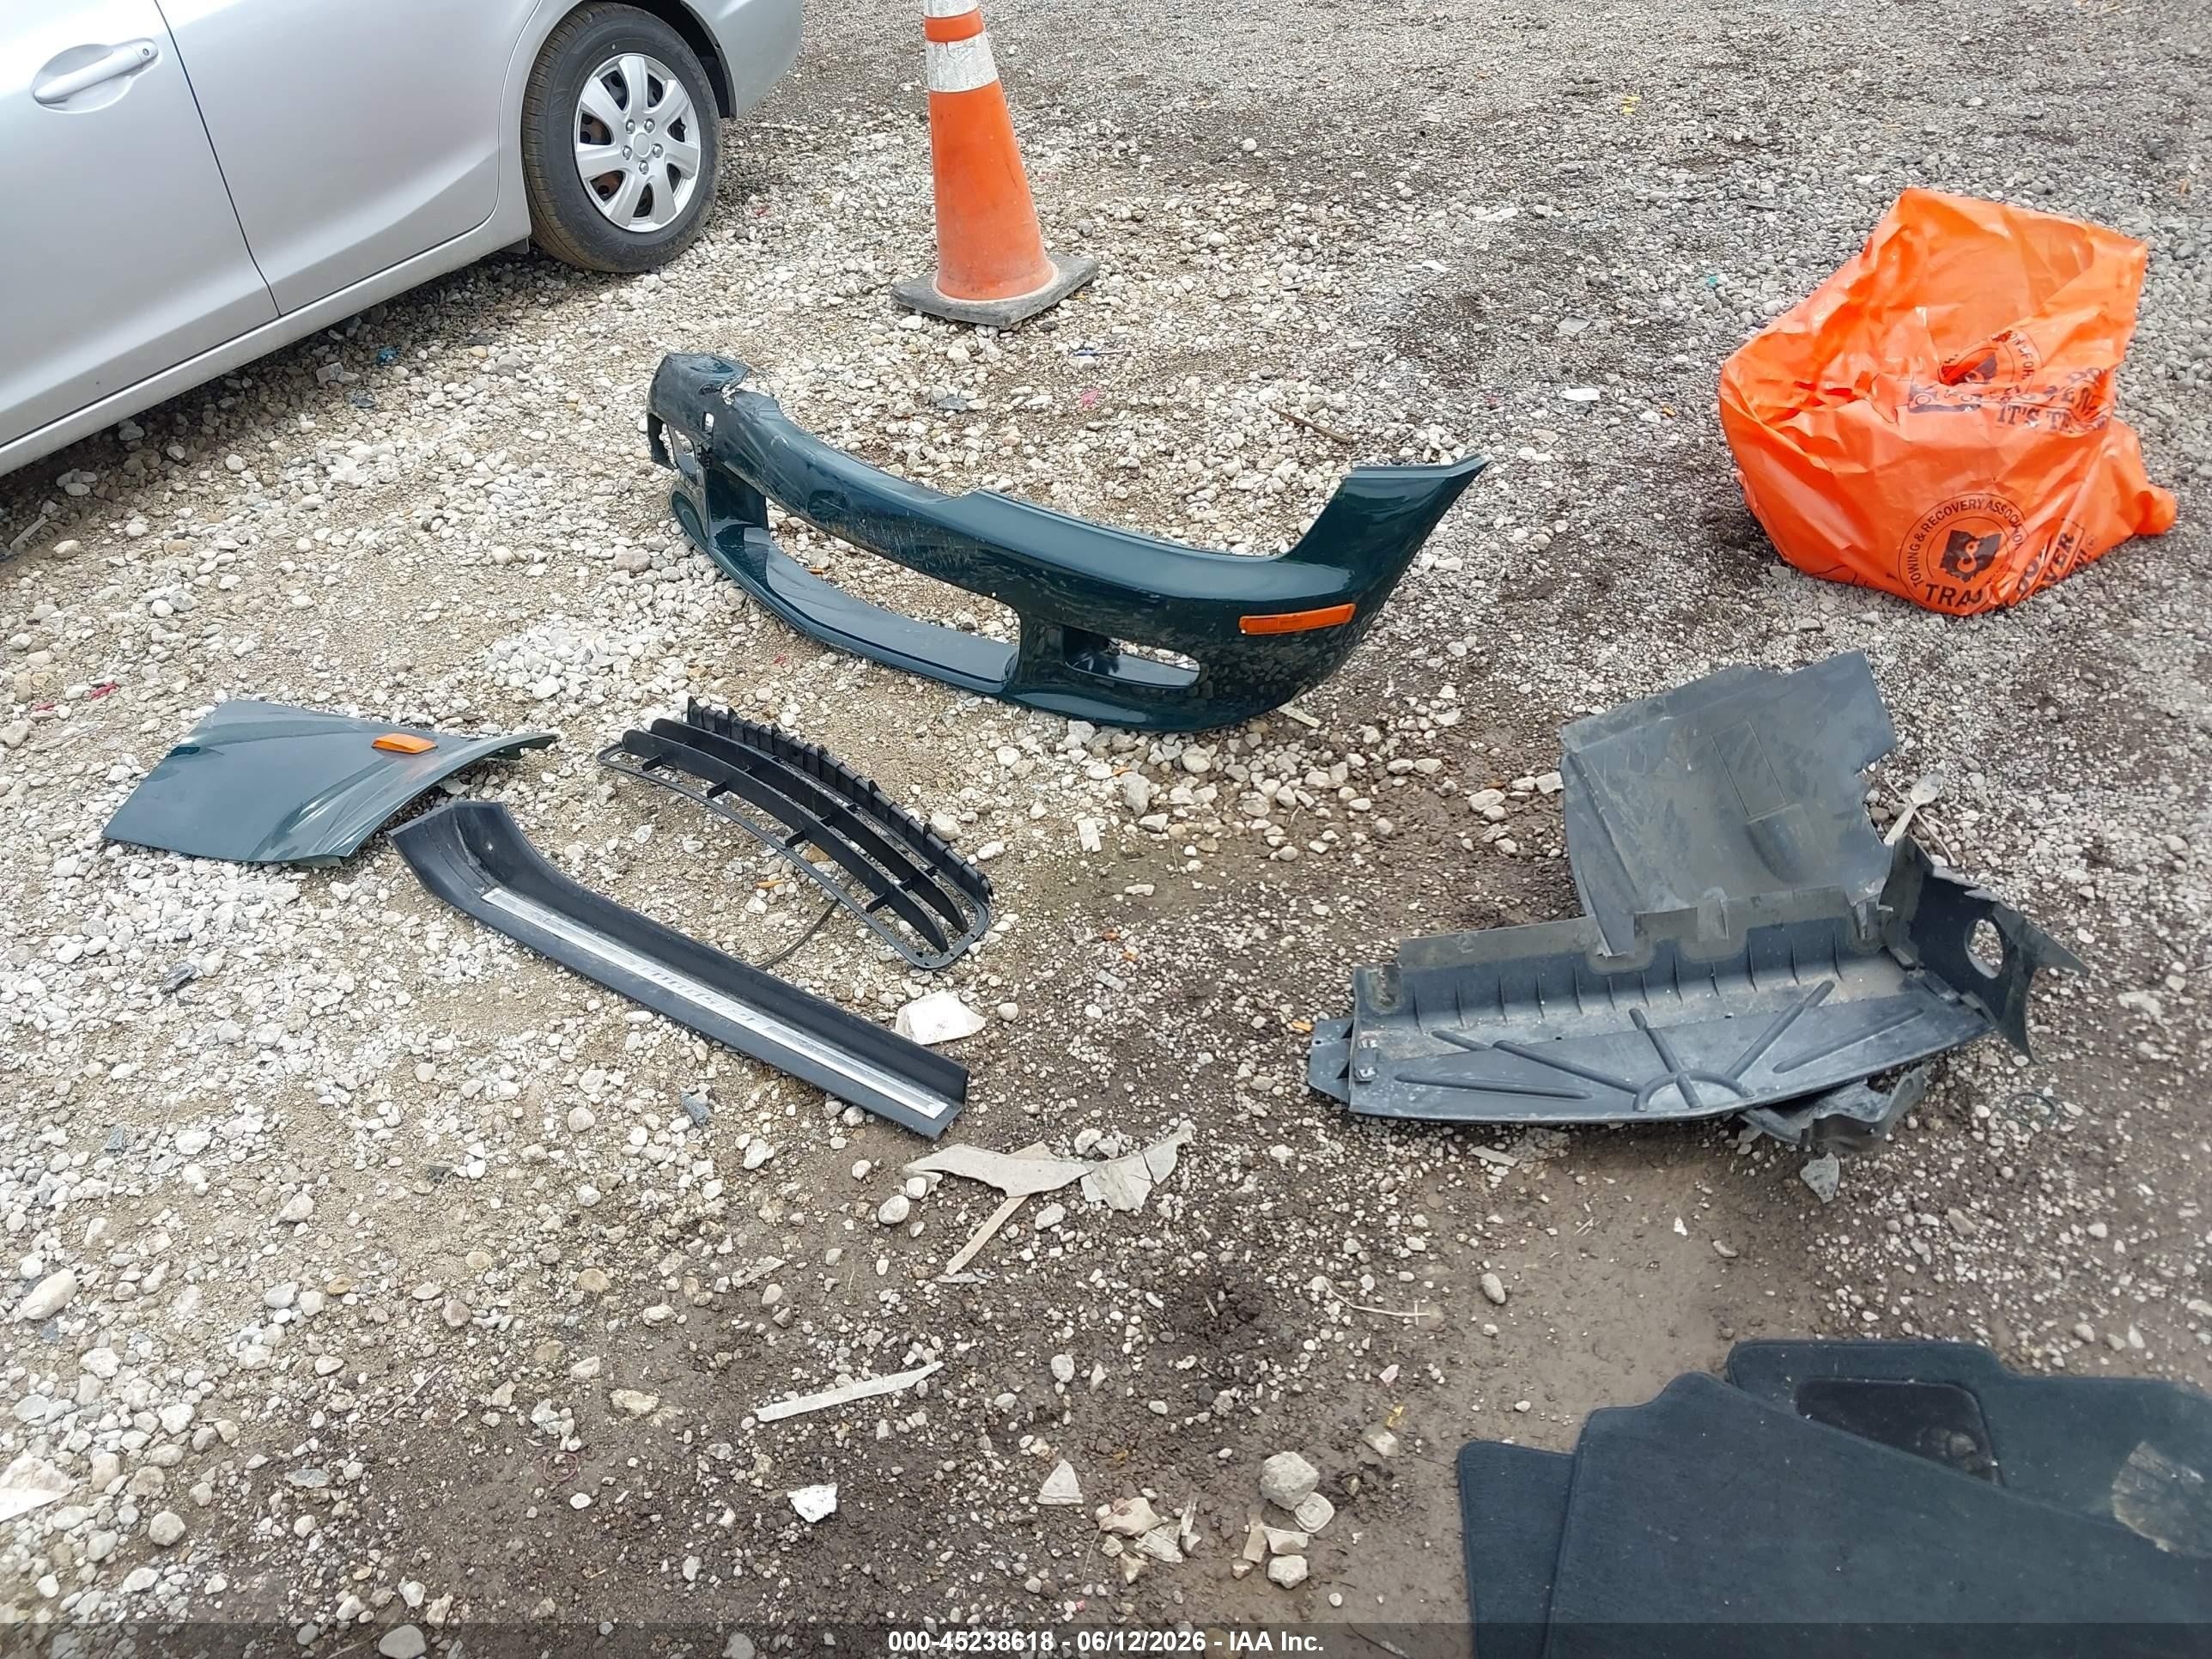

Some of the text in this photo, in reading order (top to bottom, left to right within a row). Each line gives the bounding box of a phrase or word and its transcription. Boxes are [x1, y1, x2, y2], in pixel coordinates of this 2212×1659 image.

[1997, 405, 2040, 428] IT'S
[1922, 498, 1985, 532] RECOVERY
[1914, 531, 1926, 542] &
[1906, 543, 1924, 588] TOWING
